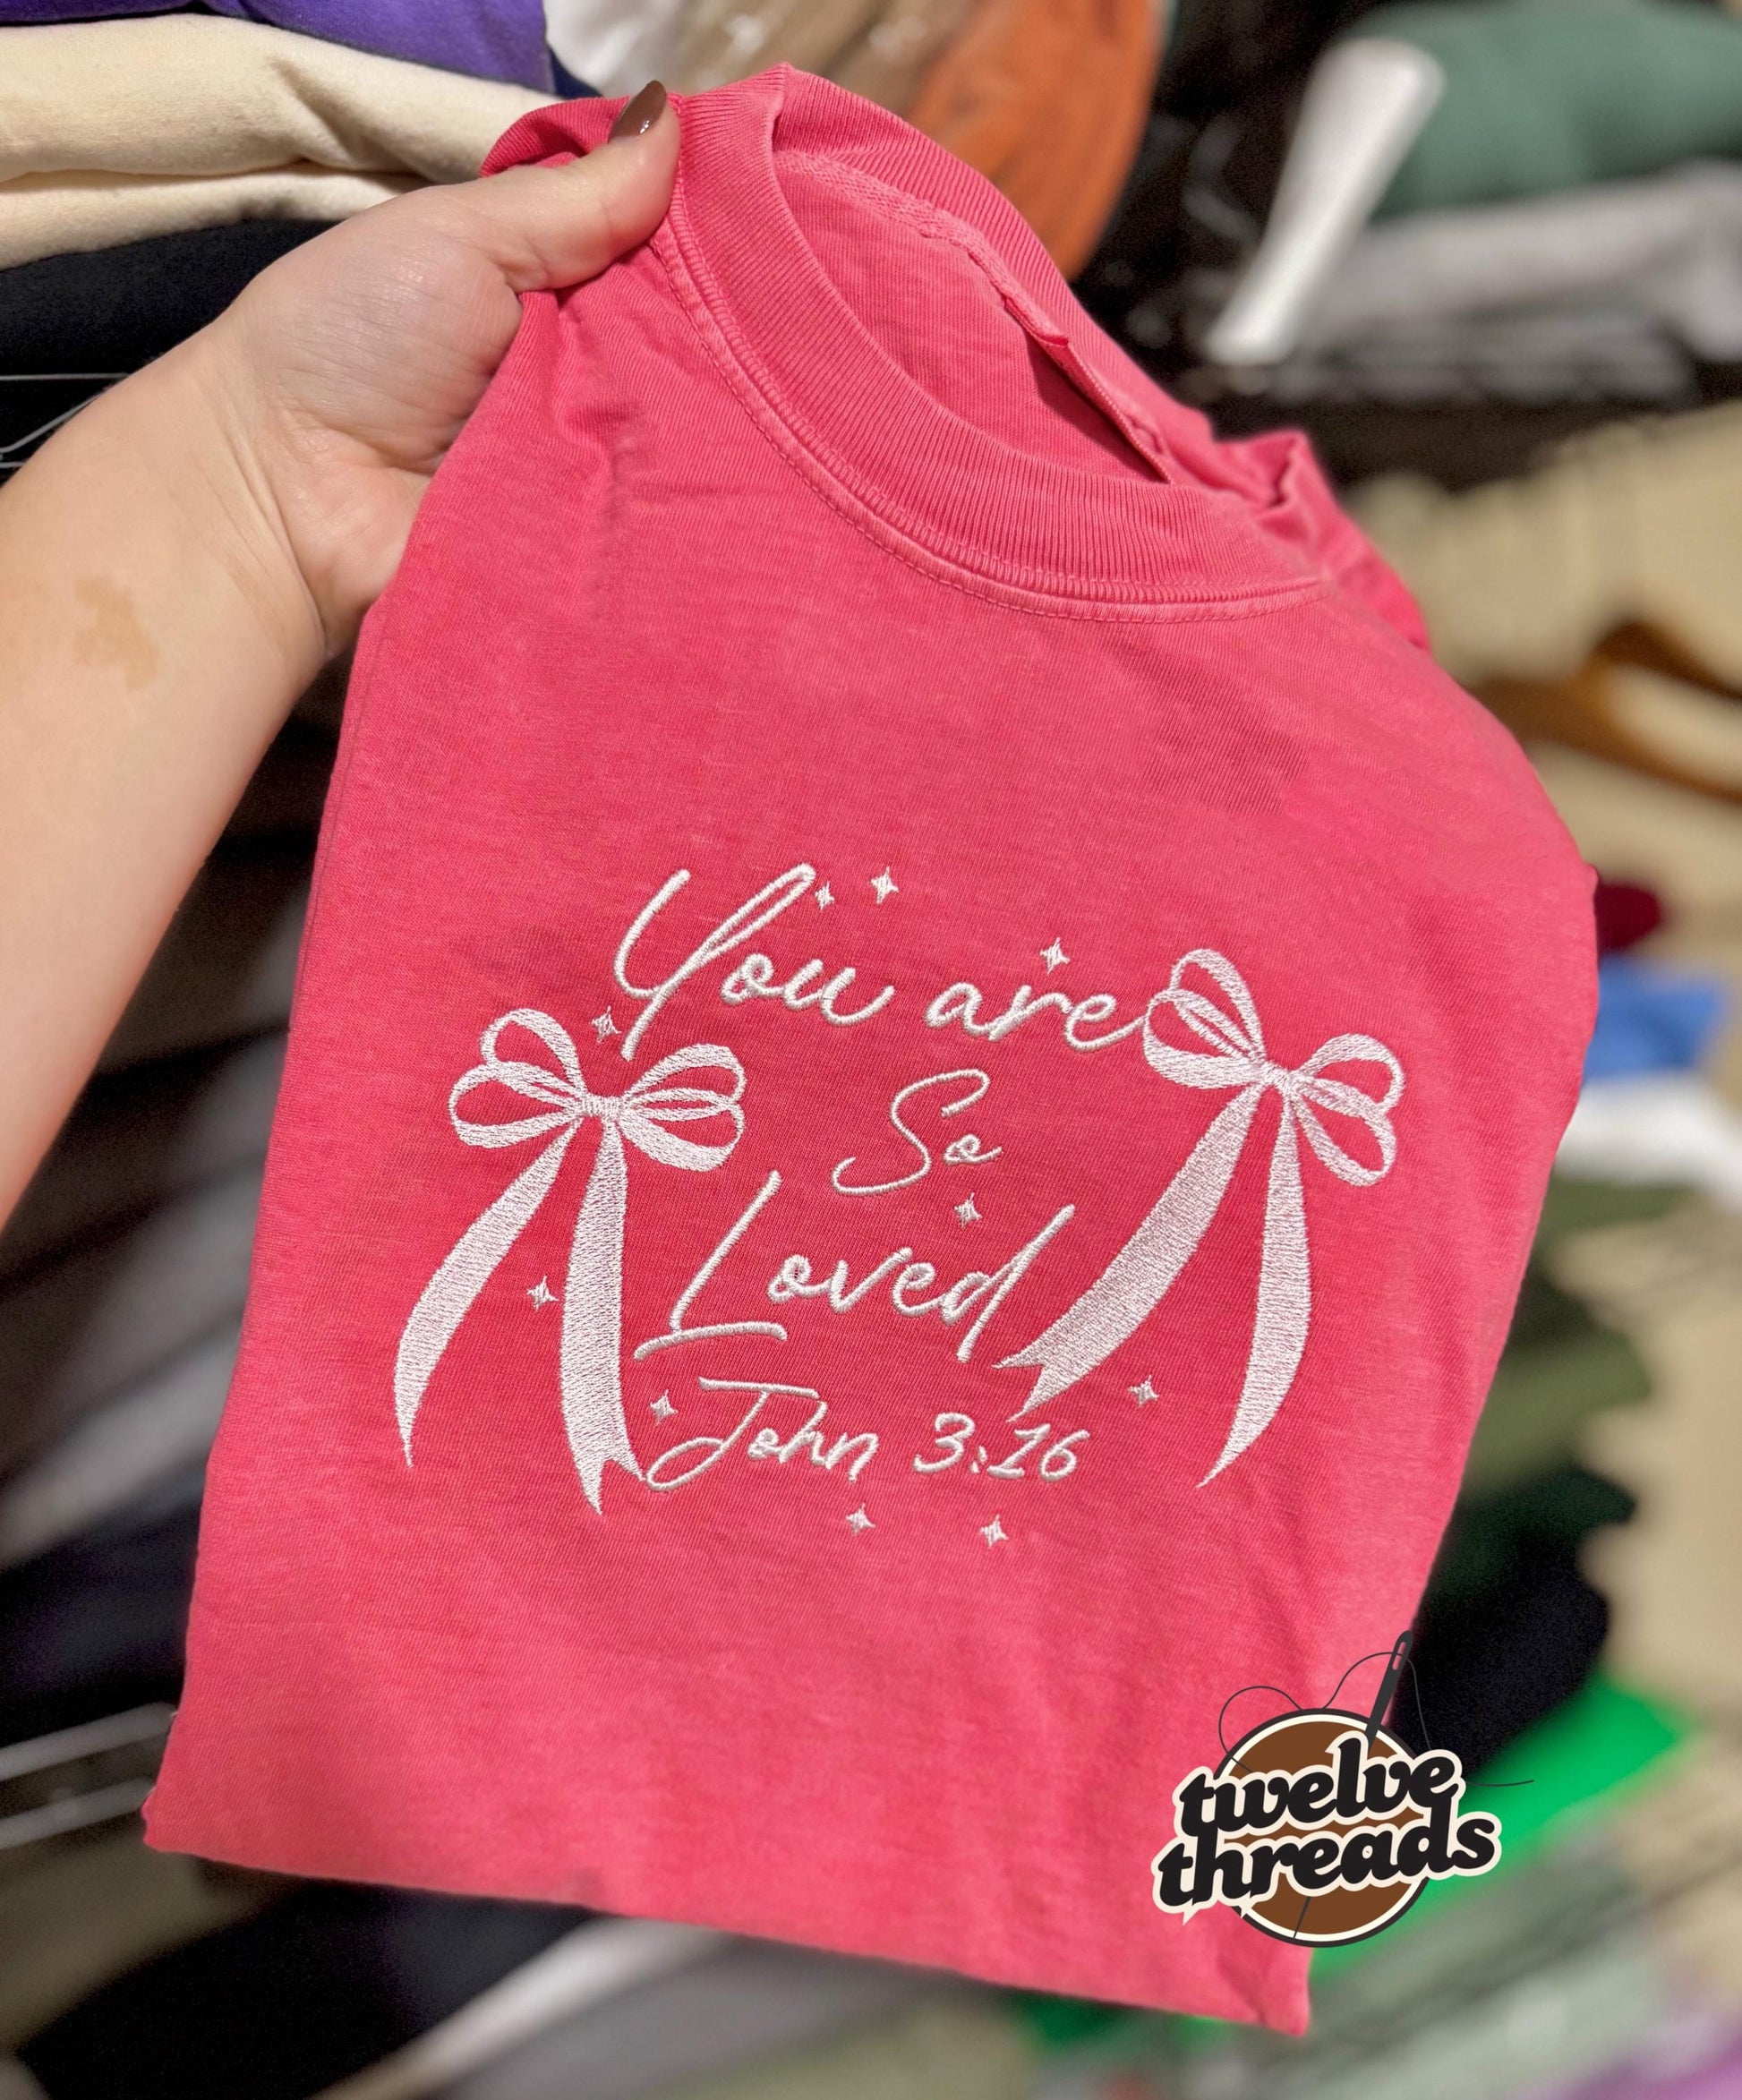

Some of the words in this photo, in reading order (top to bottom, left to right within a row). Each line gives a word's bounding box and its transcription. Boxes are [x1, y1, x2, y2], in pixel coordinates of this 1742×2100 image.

[614, 863, 895, 1061] You
[925, 983, 1146, 1052] are
[832, 1068, 1003, 1196] So
[633, 1169, 1075, 1363] Loved
[646, 1376, 880, 1491] John
[913, 1413, 1090, 1482] 3:16
